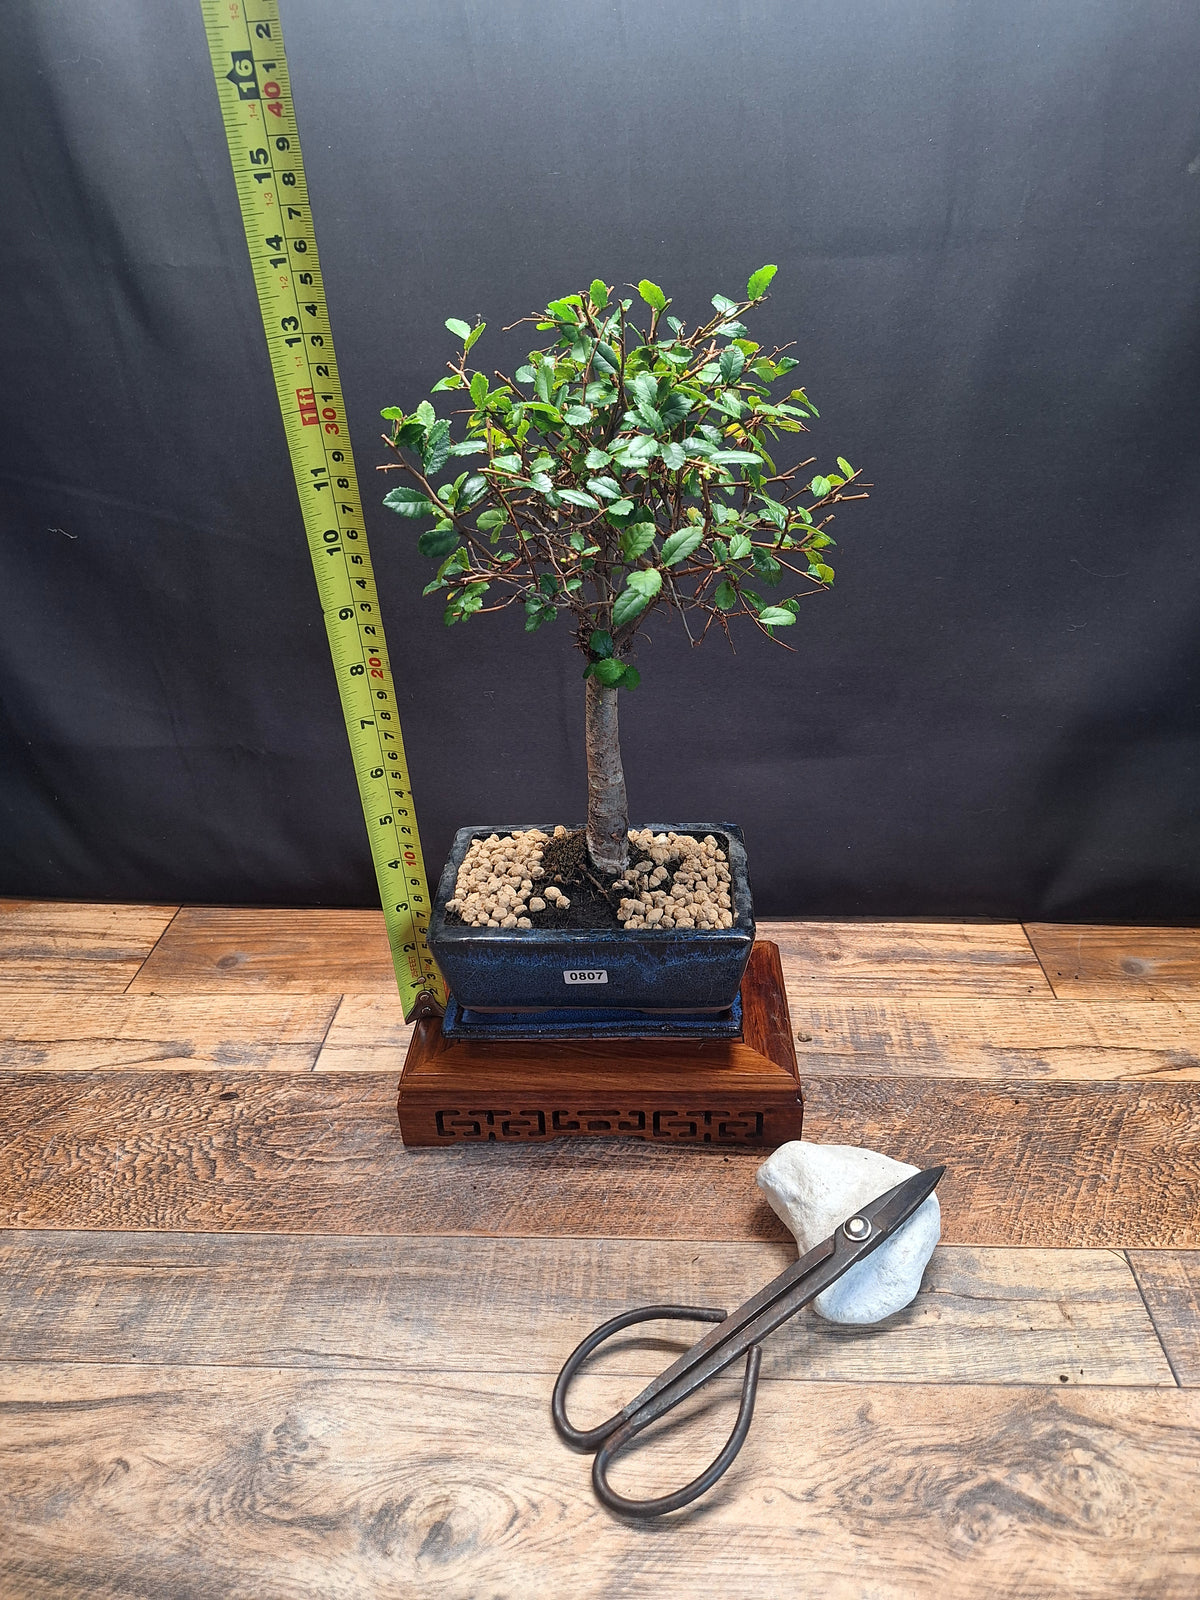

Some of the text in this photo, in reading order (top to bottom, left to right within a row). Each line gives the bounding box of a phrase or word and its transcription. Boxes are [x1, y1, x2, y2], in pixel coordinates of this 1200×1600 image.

[256, 23, 272, 39] 2
[262, 63, 276, 73] 1
[234, 59, 256, 93] 16
[264, 82, 284, 118] 40
[276, 137, 290, 151] 9
[249, 148, 272, 184] 15
[282, 172, 296, 186] 8
[288, 207, 301, 220] 7
[266, 234, 287, 268] 14
[294, 240, 307, 253] 6
[299, 273, 312, 285] 5
[305, 304, 318, 316] 4
[281, 316, 301, 348] 13
[311, 335, 323, 347] 3
[316, 365, 329, 377] 2
[322, 408, 339, 435] 30
[332, 451, 344, 462] 9
[311, 467, 329, 491] 11
[337, 478, 349, 489] 8
[342, 504, 354, 514] 7
[347, 530, 358, 540] 6
[323, 530, 341, 556] 10
[351, 555, 363, 565] 5
[356, 579, 366, 589] 4
[361, 603, 371, 612] 3
[339, 608, 353, 620] 9
[365, 626, 376, 635] 2
[350, 664, 364, 676] 8
[369, 657, 384, 679] 20
[377, 691, 387, 700] 9
[381, 712, 391, 720] 8
[360, 720, 374, 729] 7
[384, 732, 394, 740] 7
[388, 752, 398, 760] 6
[370, 768, 384, 778] 6
[379, 815, 393, 826] 5
[388, 860, 400, 869] 4
[404, 852, 416, 866] 10
[396, 903, 408, 912] 3
[403, 943, 416, 952] 2
[570, 972, 604, 980] 0807
